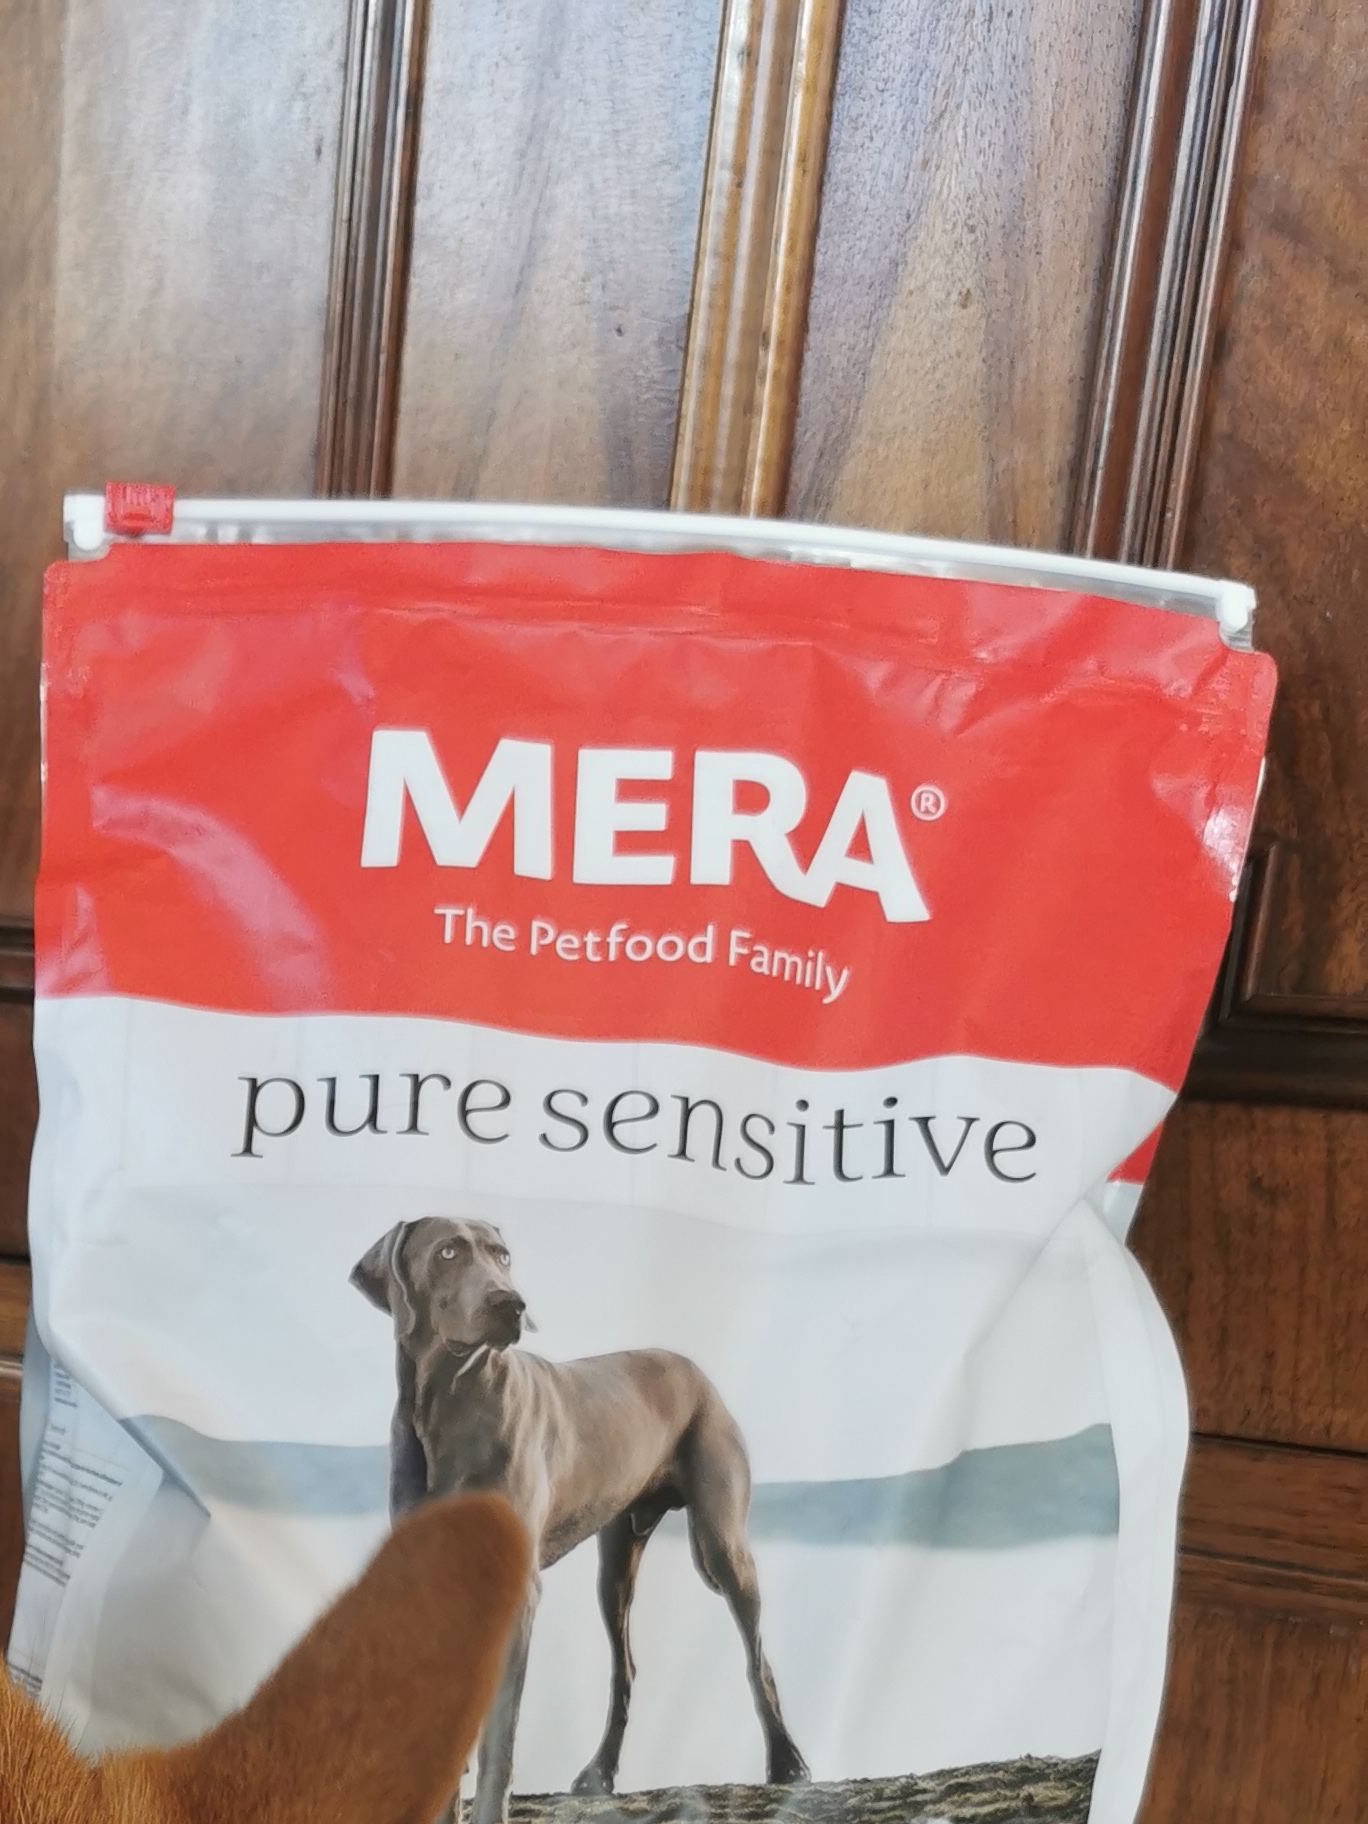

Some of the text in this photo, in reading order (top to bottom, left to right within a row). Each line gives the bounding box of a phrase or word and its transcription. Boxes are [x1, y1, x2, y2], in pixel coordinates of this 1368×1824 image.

[434, 907, 850, 1005] The Petfood Family
[230, 1069, 1038, 1186] pure sensitive
